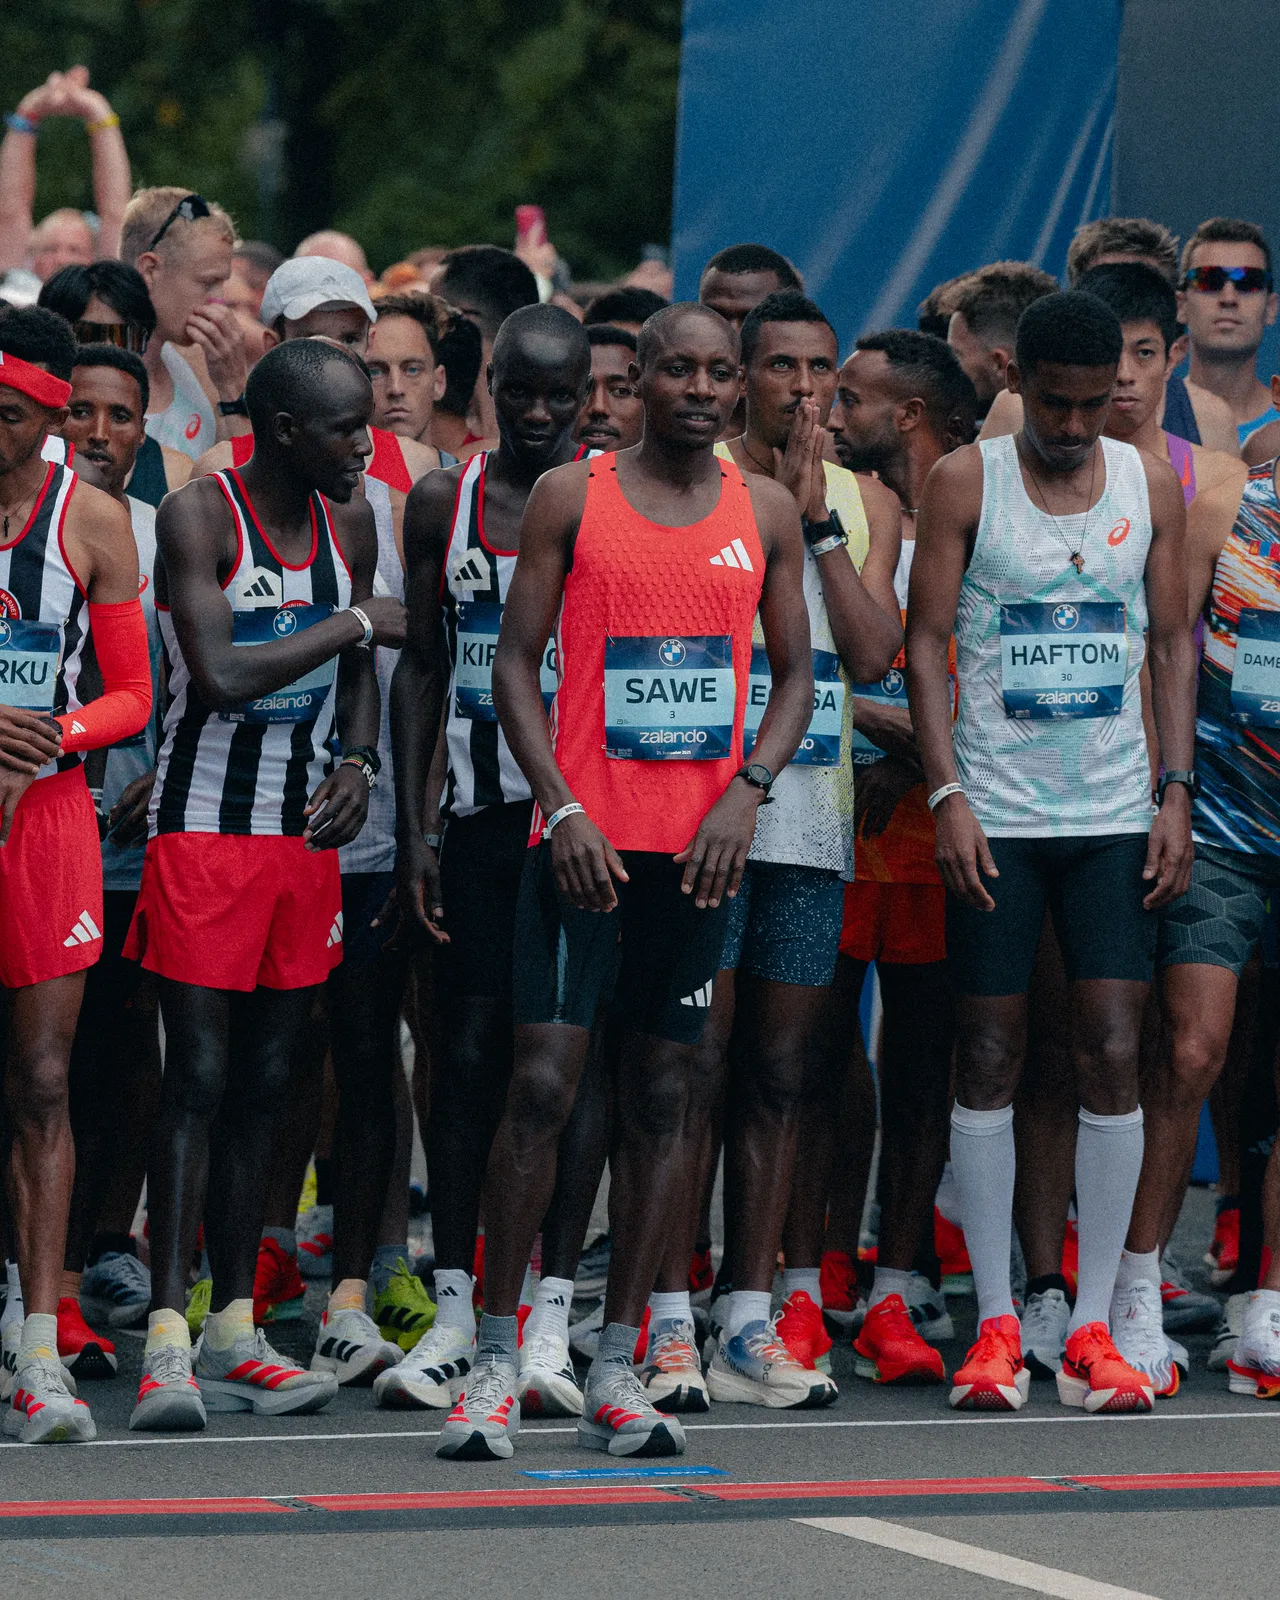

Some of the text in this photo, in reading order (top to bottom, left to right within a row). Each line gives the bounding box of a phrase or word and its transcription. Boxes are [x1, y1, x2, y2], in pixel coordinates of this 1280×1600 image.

[1, 592, 17, 616] BARNET
[1011, 643, 1119, 666] HAFTOM
[1061, 673, 1072, 682] 30
[625, 677, 717, 704] SAWE
[1035, 690, 1098, 705] zalando
[253, 693, 312, 711] zalando
[669, 710, 676, 719] 3
[639, 729, 707, 744] zalando
